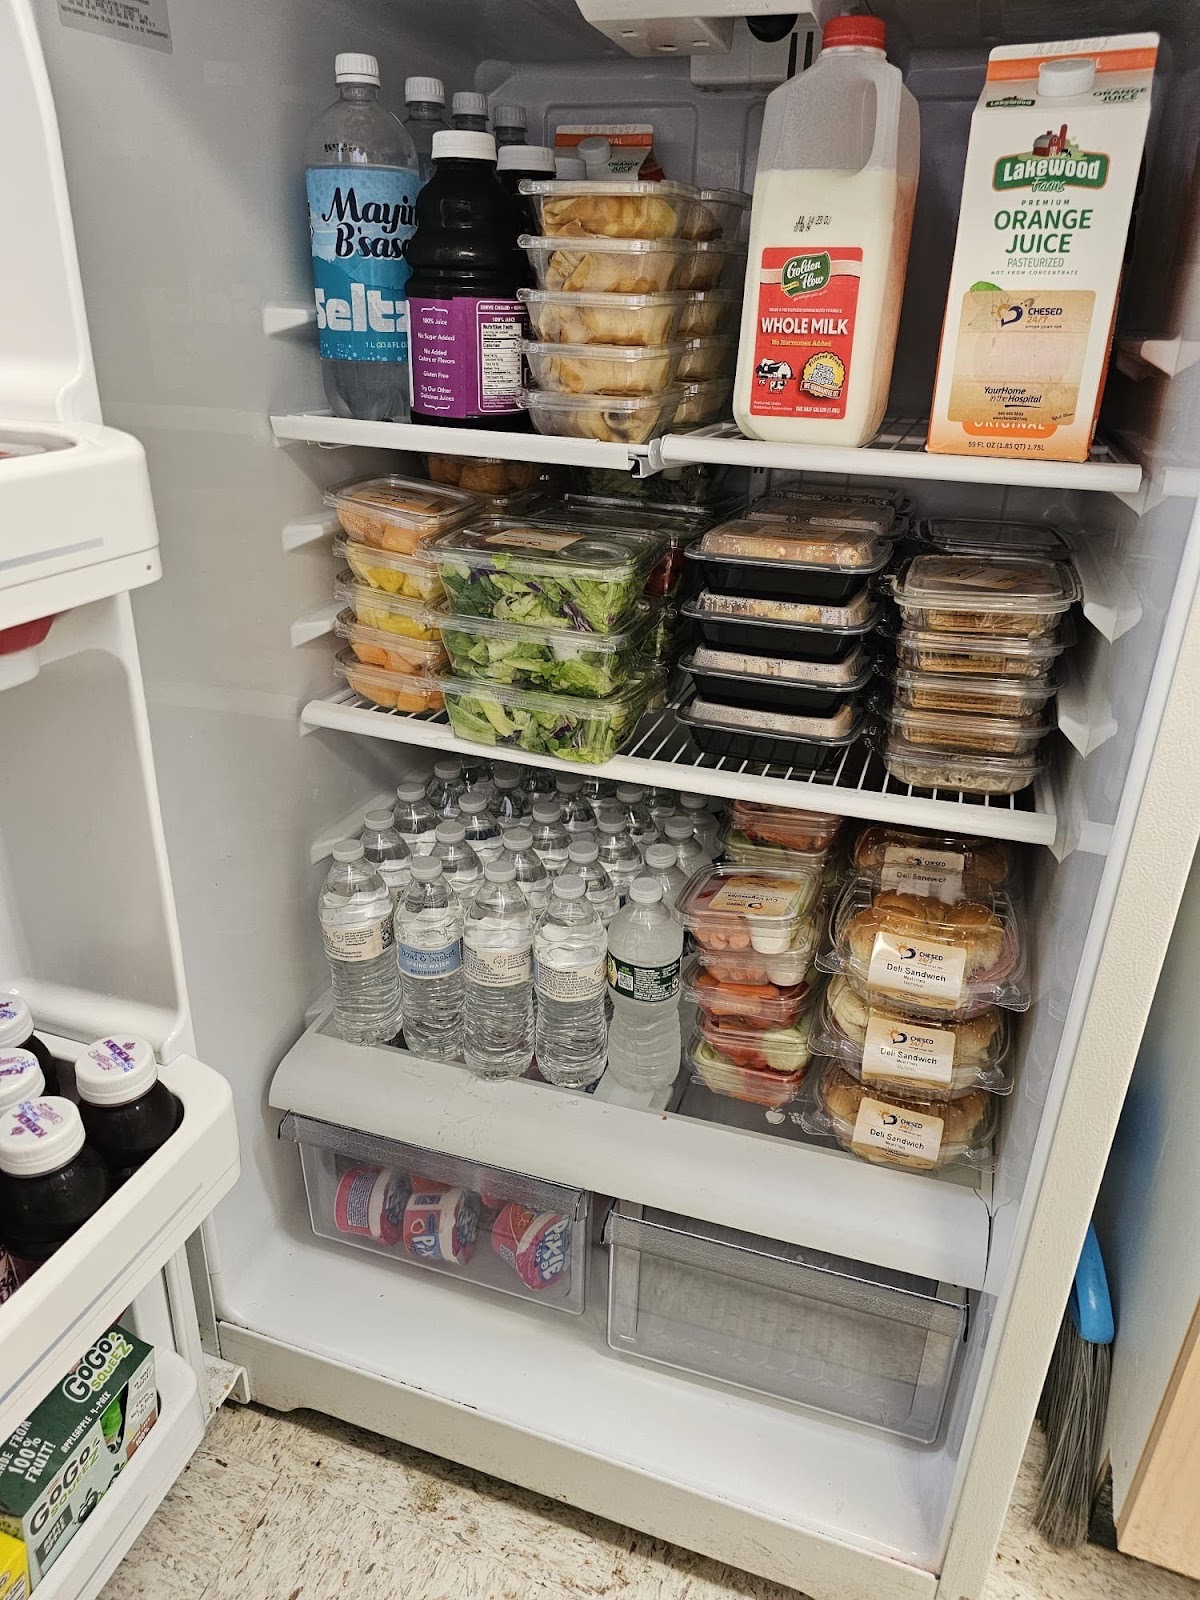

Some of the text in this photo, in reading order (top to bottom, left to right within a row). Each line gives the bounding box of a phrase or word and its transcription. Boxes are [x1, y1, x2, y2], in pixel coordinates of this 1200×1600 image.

[1092, 86, 1148, 97] ORANGE
[1102, 94, 1138, 102] JUICE
[1003, 159, 1101, 182] Lakewood
[1031, 176, 1066, 193] Farms
[994, 208, 1094, 231] ORANGE
[1005, 233, 1073, 254] JUICE
[787, 259, 821, 279] Golden
[1007, 257, 1065, 268] PASTEURIZED
[800, 273, 825, 289] Flow
[1028, 307, 1063, 316] CHESED
[422, 317, 435, 325] 100%
[761, 317, 849, 335] WHOLE MILK
[1026, 316, 1049, 324] 24/7
[424, 333, 437, 341] Sugar
[418, 355, 431, 363] Colors
[437, 357, 455, 365] Flavors
[423, 370, 437, 378] Gluten
[428, 385, 437, 393] Our
[984, 386, 1027, 395] YourHome
[420, 392, 455, 402] Delicious Juices
[1008, 395, 1042, 404] Hospital
[996, 442, 1013, 450] (1.85
[912, 873, 948, 883] Sandwich
[401, 947, 418, 961] bowl
[429, 949, 456, 962] basket
[919, 951, 944, 962] CHESED
[406, 960, 450, 969] SPRING WATER
[886, 963, 903, 973] Deli
[904, 967, 946, 982] Sandwich
[910, 1035, 934, 1045] CHESED
[103, 1039, 135, 1063] KEDEM
[880, 1047, 937, 1065] Deli Sandwich
[12, 1113, 48, 1138] KEDEM
[900, 1118, 923, 1129] CHESED
[869, 1128, 885, 1139] Deli
[886, 1133, 925, 1150] Sandwich
[540, 1217, 570, 1280] PIXIE
[91, 1341, 132, 1390] SQUEEZ
[60, 1391, 112, 1453] APPLEAPPLE 4-PACK
[0, 1421, 32, 1476] ADE FROM
[8, 1437, 42, 1475] 100%
[25, 1441, 56, 1483] FRUIT!
